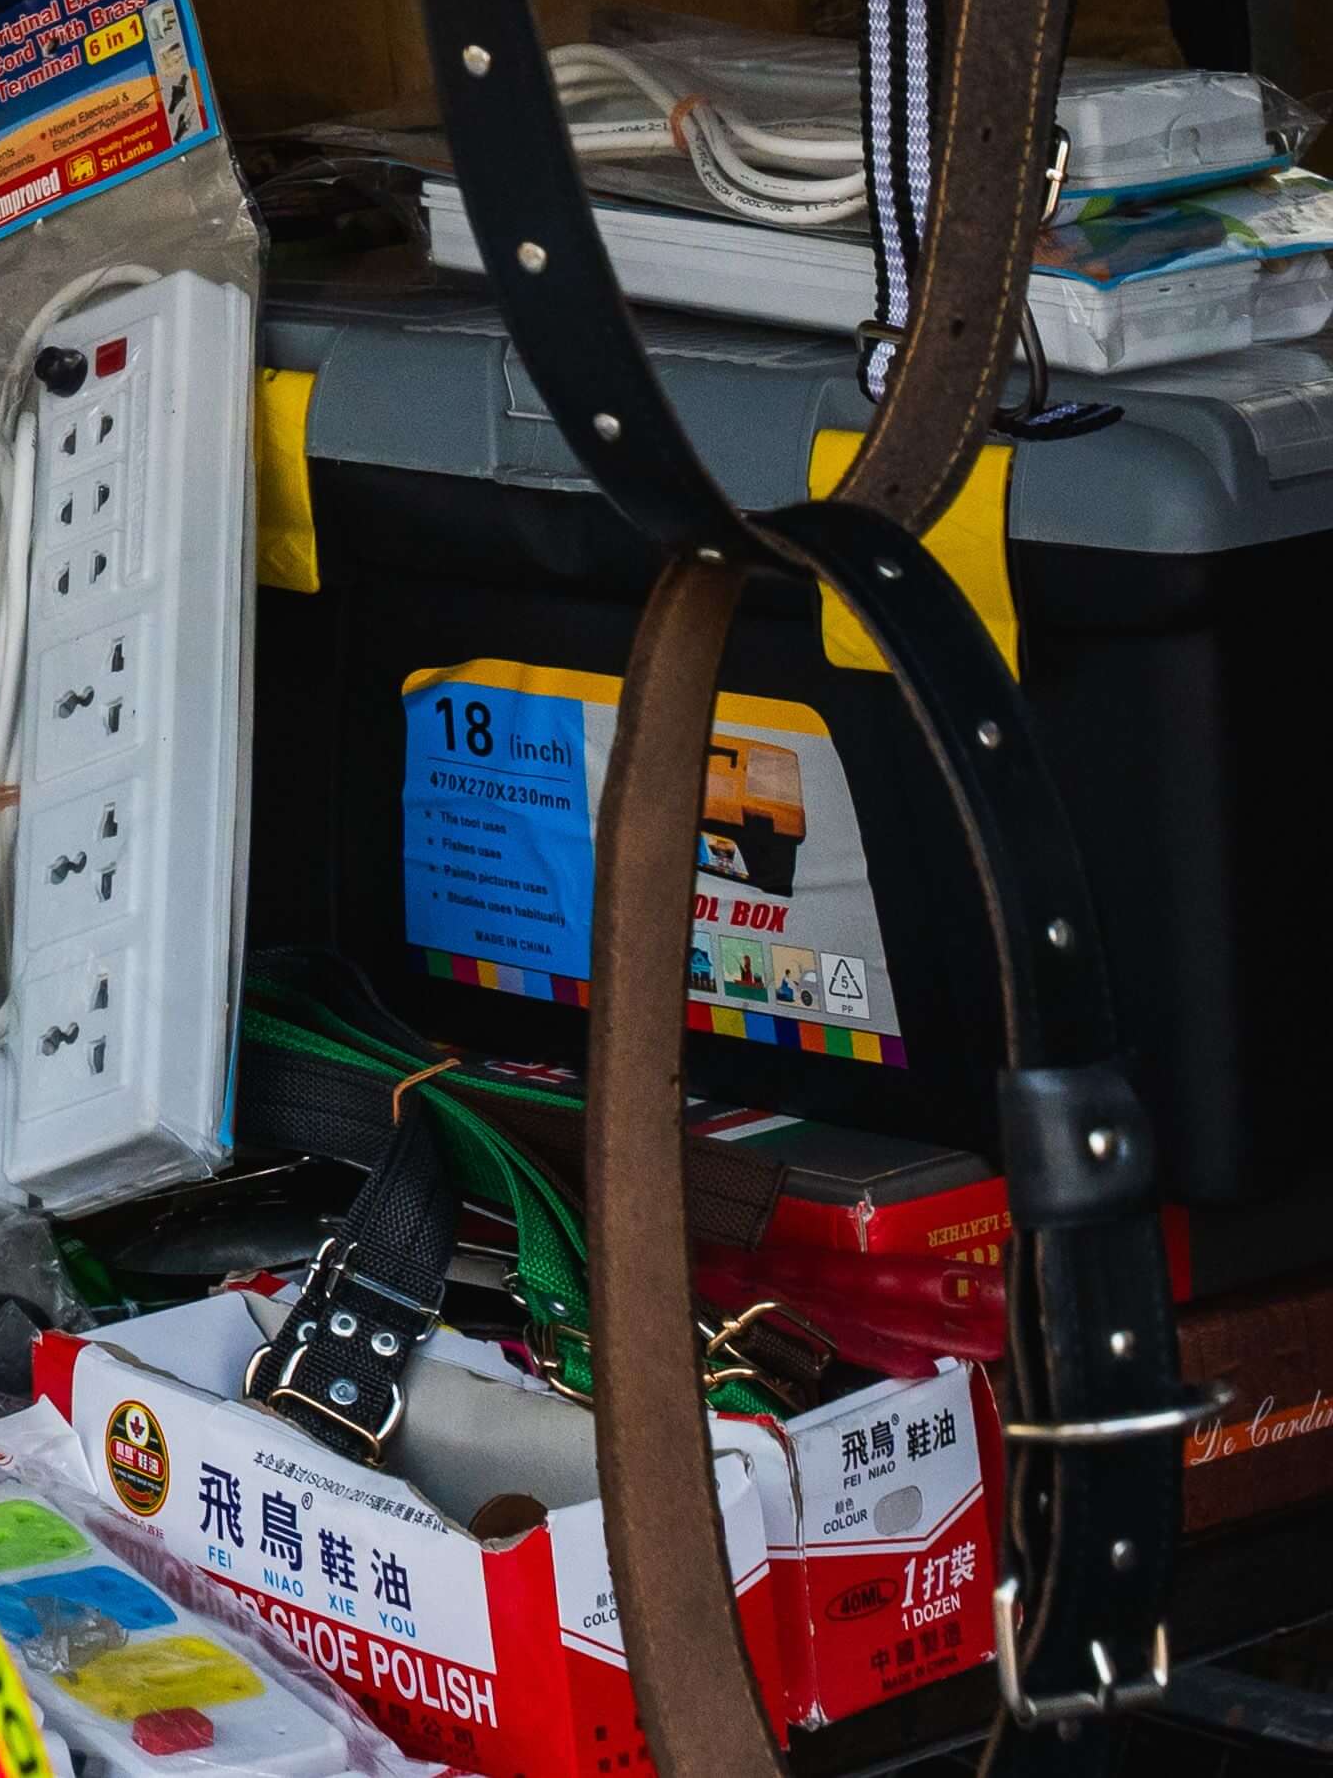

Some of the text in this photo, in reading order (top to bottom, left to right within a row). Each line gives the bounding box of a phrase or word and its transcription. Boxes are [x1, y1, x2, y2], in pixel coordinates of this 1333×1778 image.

[89, 38, 101, 57] 6
[107, 29, 124, 50] in
[129, 19, 141, 38] 1
[47, 117, 78, 138] Home
[78, 97, 120, 125] Electrical
[100, 141, 154, 173] Sri Lanka
[436, 697, 573, 767] 18 (inch)
[440, 810, 458, 826] The
[482, 821, 507, 835] uses
[476, 847, 502, 861] uses
[522, 882, 548, 896] uses
[729, 899, 790, 934] BOX
[474, 930, 505, 946] MADE
[519, 936, 553, 956] CHINA
[843, 1460, 896, 1491] FEI NIAO
[823, 1508, 868, 1536] COLOUR
[207, 1545, 417, 1639] FEI NIAO XIE YOU
[583, 1608, 620, 1629] COLO
[912, 1594, 961, 1628] DOZEN
[368, 1639, 500, 1730] POLISH
